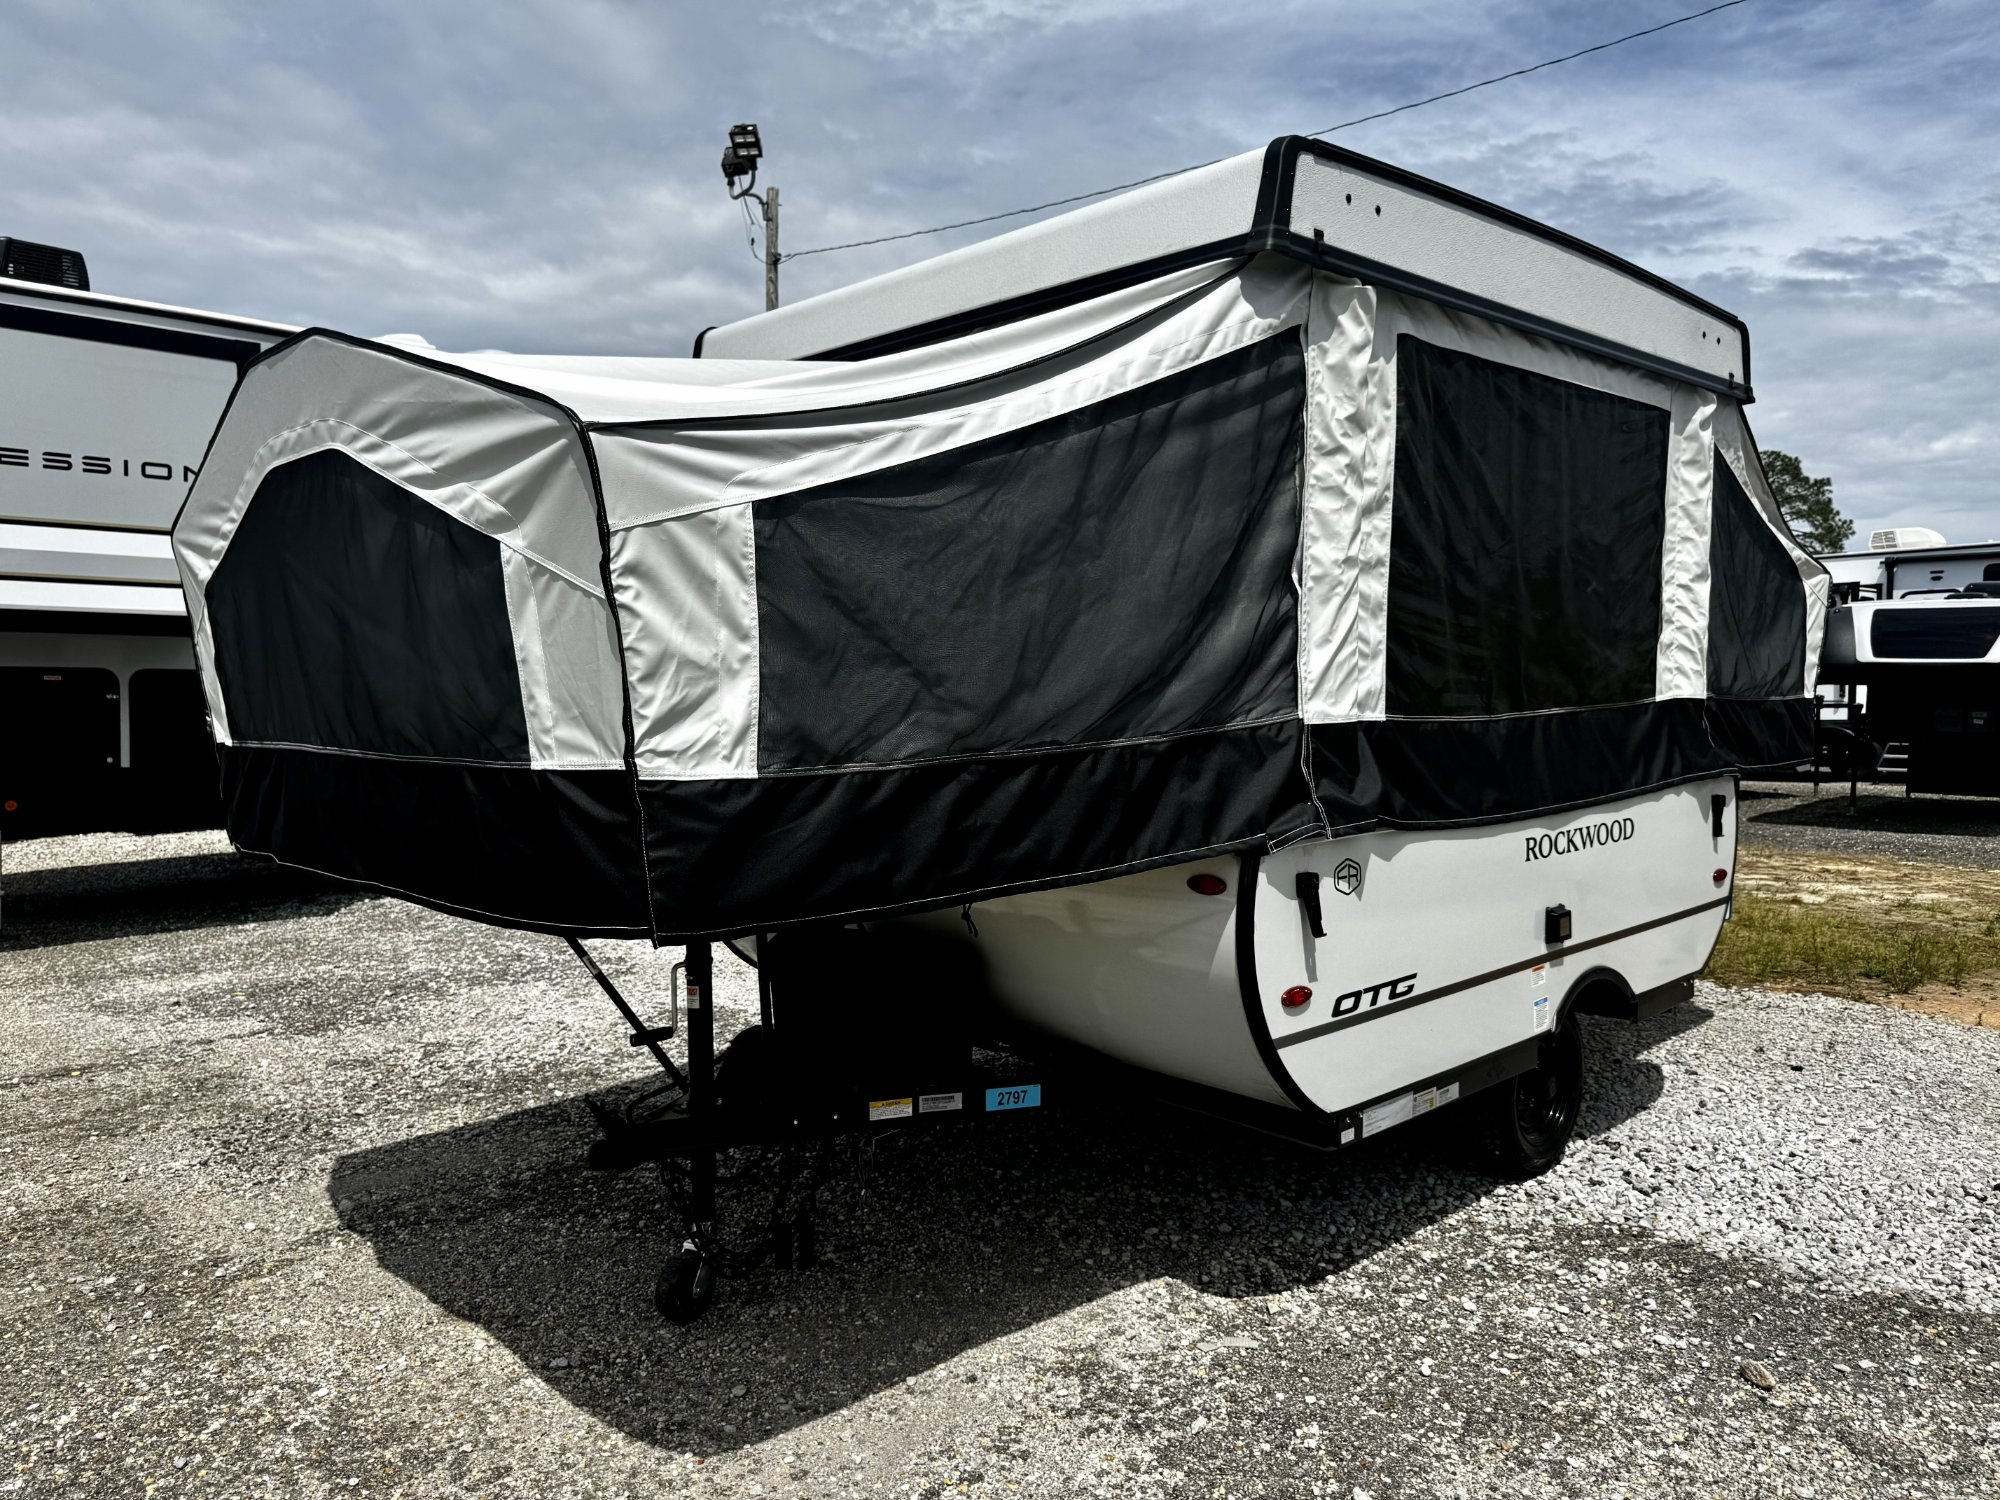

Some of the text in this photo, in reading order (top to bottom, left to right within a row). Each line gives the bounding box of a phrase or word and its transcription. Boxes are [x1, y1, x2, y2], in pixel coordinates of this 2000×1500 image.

[1525, 818, 1634, 862] ROCKWOOD
[1331, 972, 1417, 1018] OTG
[997, 1090, 1027, 1106] 2797
